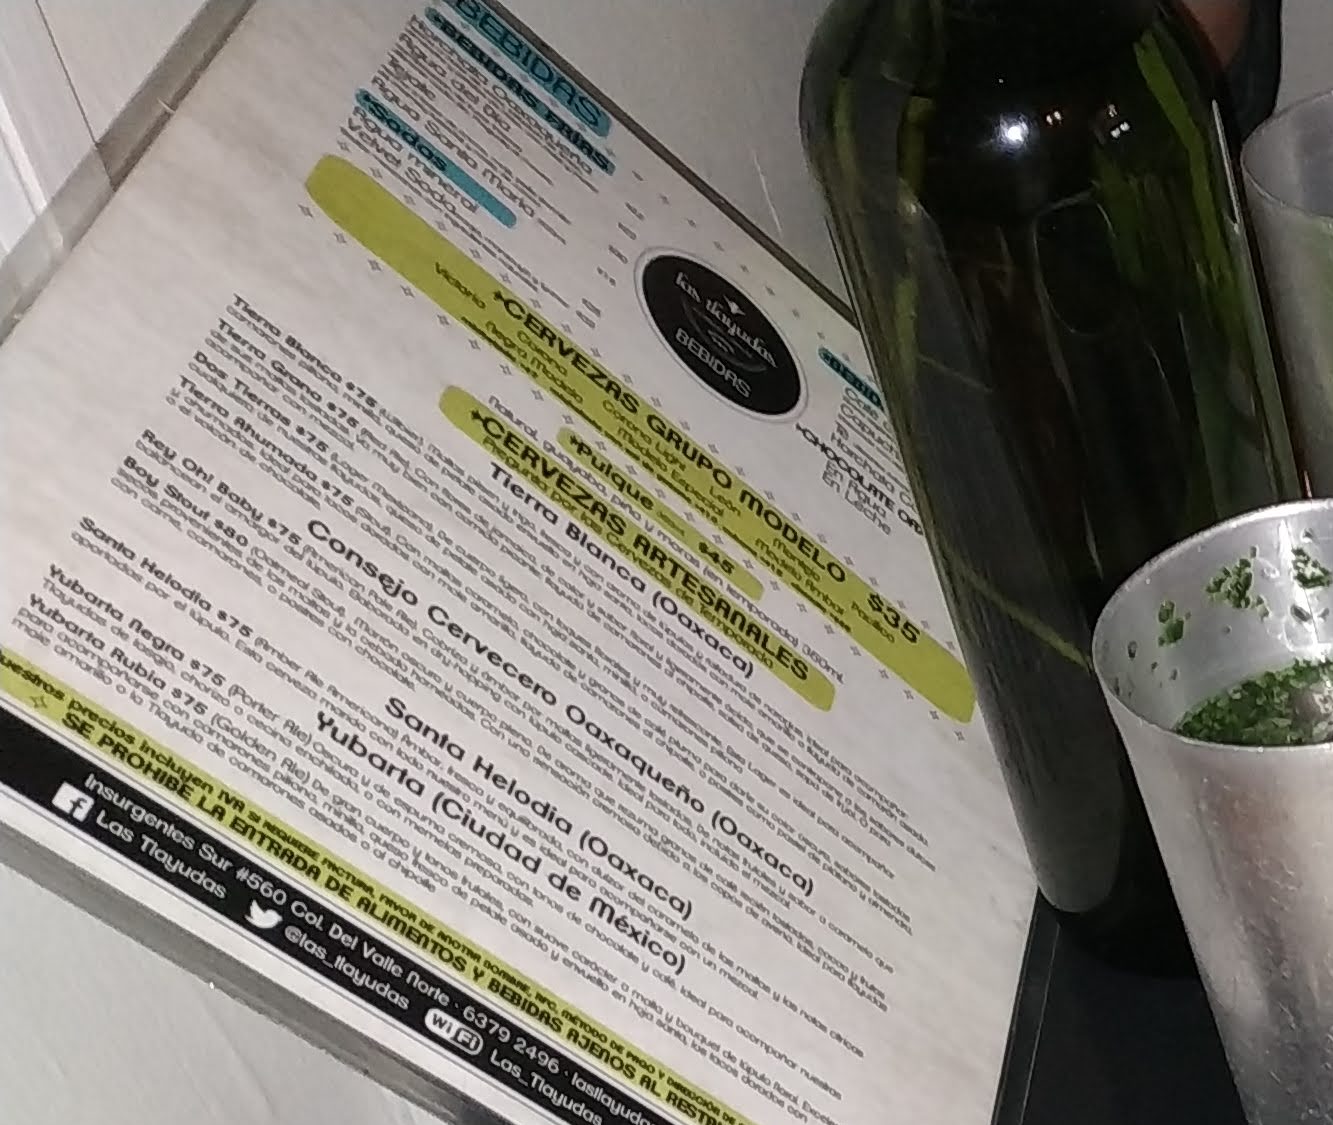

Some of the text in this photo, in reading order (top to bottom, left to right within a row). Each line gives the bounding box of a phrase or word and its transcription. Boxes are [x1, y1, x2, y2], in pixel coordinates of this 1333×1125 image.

[351, 105, 403, 154] Agua
[367, 99, 449, 172] Sodas
[404, 165, 457, 215] Soda
[193, 350, 229, 381] Dos
[231, 377, 293, 428] Tierras
[214, 317, 267, 361] Tierra
[269, 358, 323, 403] Grana
[229, 293, 282, 338] Tierra
[283, 333, 344, 384] Blanca
[674, 326, 751, 399] BEBIDAS
[175, 373, 231, 419] Tierra
[232, 414, 318, 482] Ahumada
[501, 294, 641, 416] CERVEZAS
[644, 410, 733, 492] GRUPO
[738, 486, 847, 586] MODELO
[865, 589, 920, 646] $35
[530, 355, 584, 405] Modelo
[616, 425, 669, 474] Modelo
[801, 426, 895, 512] CHOCOLATE
[121, 455, 160, 488] Boy
[163, 483, 211, 522] Stout
[212, 517, 250, 549] $80
[139, 427, 180, 462] Rey
[214, 480, 265, 522] Baby
[265, 515, 302, 547] $75
[573, 439, 655, 515] Pulque
[697, 539, 734, 576] $45
[643, 519, 654, 533] y
[847, 479, 887, 521] Agua
[78, 516, 136, 560] Santa
[138, 556, 213, 613] Helodia
[214, 607, 254, 640] $75
[480, 413, 628, 538] CERVEZAS
[632, 531, 810, 682] ARTESANALES
[486, 460, 560, 526] Tierra
[564, 520, 648, 594] Blanca
[650, 587, 755, 681] (Oaxaca)
[25, 593, 106, 651] Yubarta
[108, 645, 168, 691] Rubia
[169, 684, 208, 716] $75
[46, 563, 126, 622] Yubarta
[126, 616, 186, 664] Negra
[188, 656, 227, 688] $75
[66, 697, 137, 747] precios
[137, 740, 216, 797] incluyen
[216, 788, 246, 814] IVA
[302, 515, 815, 899] Consejo Cervecero Oaxaqueño (Oaxaca)
[95, 809, 138, 843] Las
[134, 833, 230, 902] Tlayudas
[311, 710, 688, 977] Yubarta (Ciudad de México)
[383, 694, 694, 923] Santa Helodia (Oaxaca)
[60, 711, 96, 740] SE
[96, 733, 194, 802] PROHIBE
[195, 795, 226, 823] LA
[228, 816, 321, 883] ENTRADA
[323, 875, 354, 904] DE
[355, 896, 467, 975] ALIMENTOS
[469, 967, 484, 986] Y
[486, 978, 563, 1036] BEBIDAS
[564, 1027, 636, 1082] AJENOS
[638, 1073, 663, 1099] AL
[81, 772, 198, 852] Insurgentes
[196, 841, 233, 872] Sur
[234, 865, 288, 906] #560
[327, 922, 357, 949] Del
[359, 941, 405, 979] Valle
[404, 969, 451, 1007] Norte
[461, 1004, 512, 1044] 6379
[513, 1035, 562, 1075] 2496
